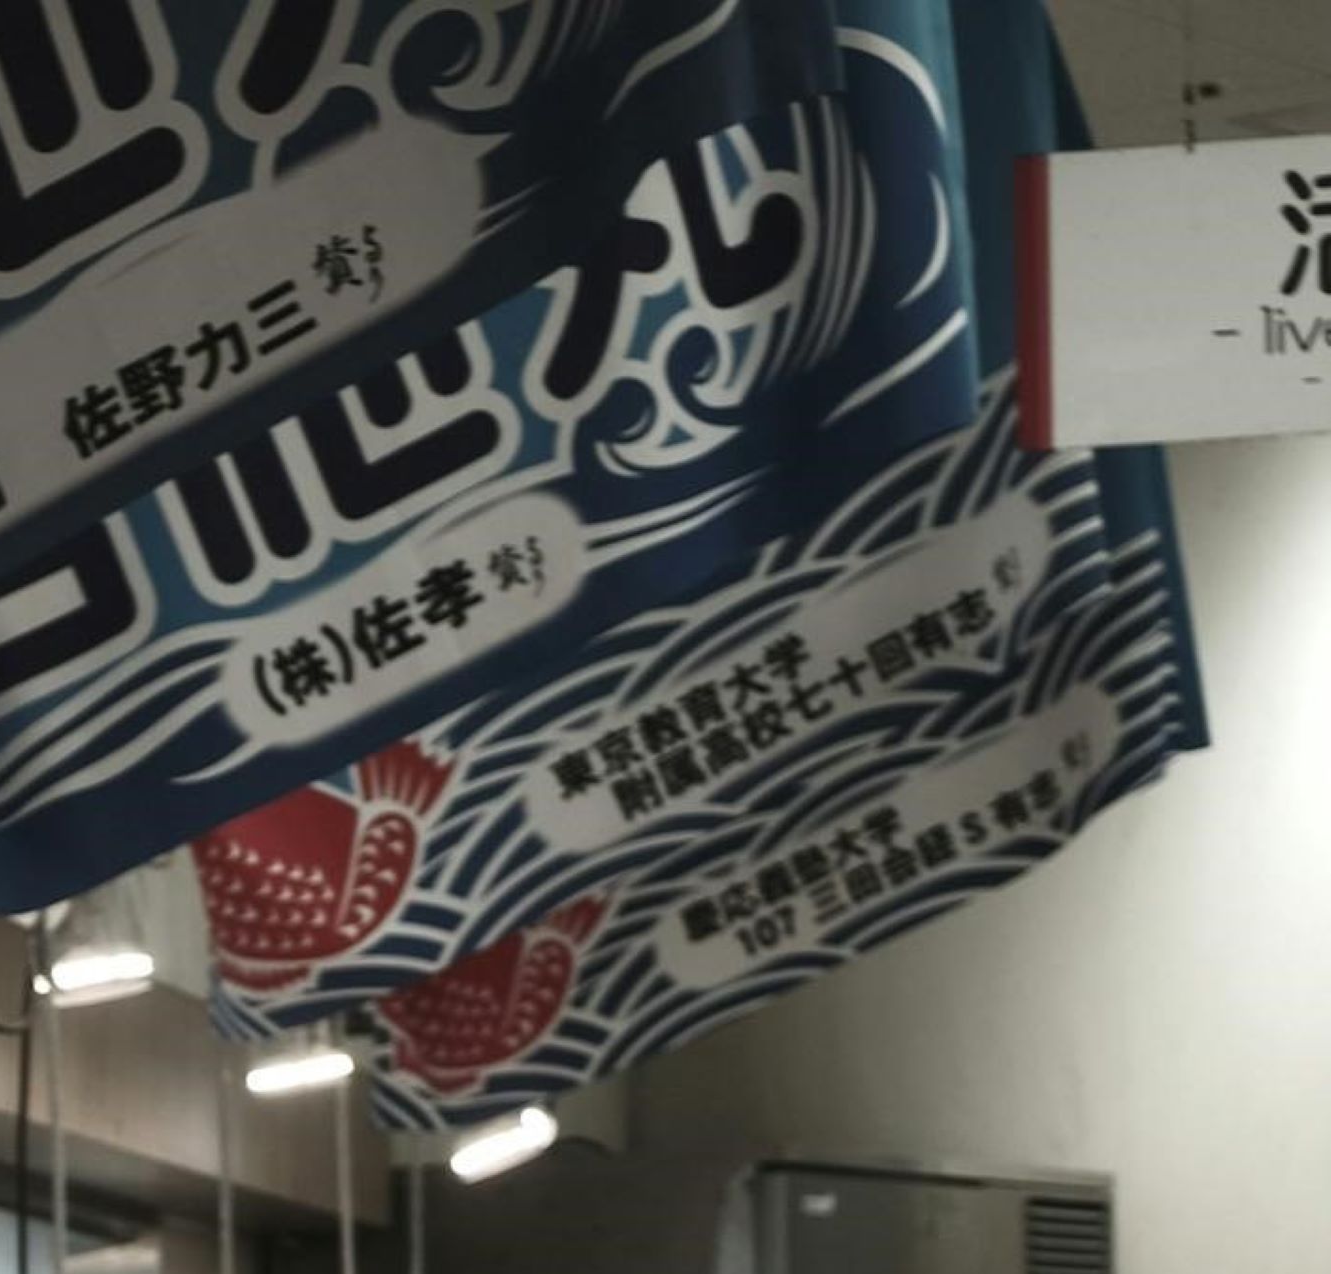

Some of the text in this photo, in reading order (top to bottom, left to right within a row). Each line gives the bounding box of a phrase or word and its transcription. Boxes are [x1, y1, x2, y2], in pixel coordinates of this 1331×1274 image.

[61, 283, 319, 461] 佐野力三
[250, 561, 485, 719] (株)佐孝
[549, 631, 814, 801] 東京教育大学
